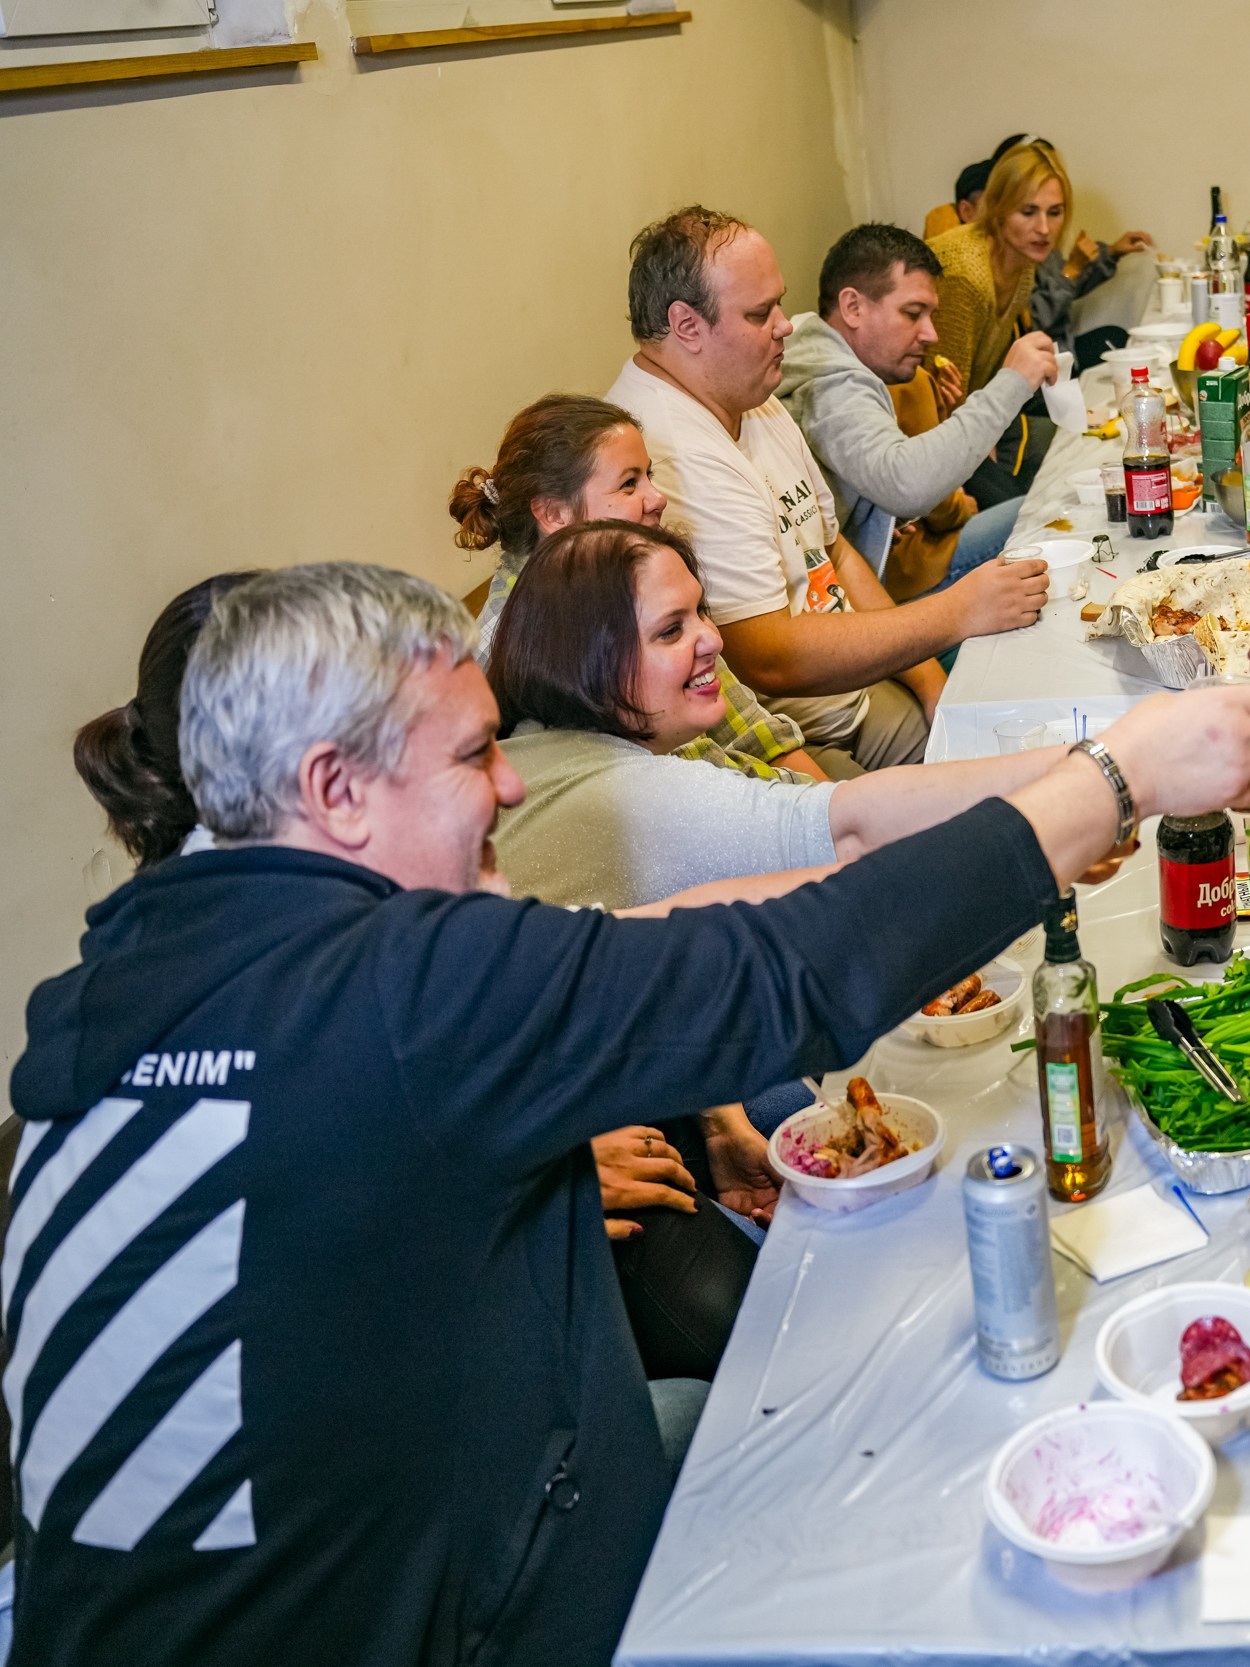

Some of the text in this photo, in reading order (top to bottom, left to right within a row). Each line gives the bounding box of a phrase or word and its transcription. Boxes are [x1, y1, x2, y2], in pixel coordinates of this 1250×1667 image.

[1197, 876, 1235, 908] Добр
[1221, 899, 1235, 917] col
[121, 1050, 256, 1087] ENIM"
